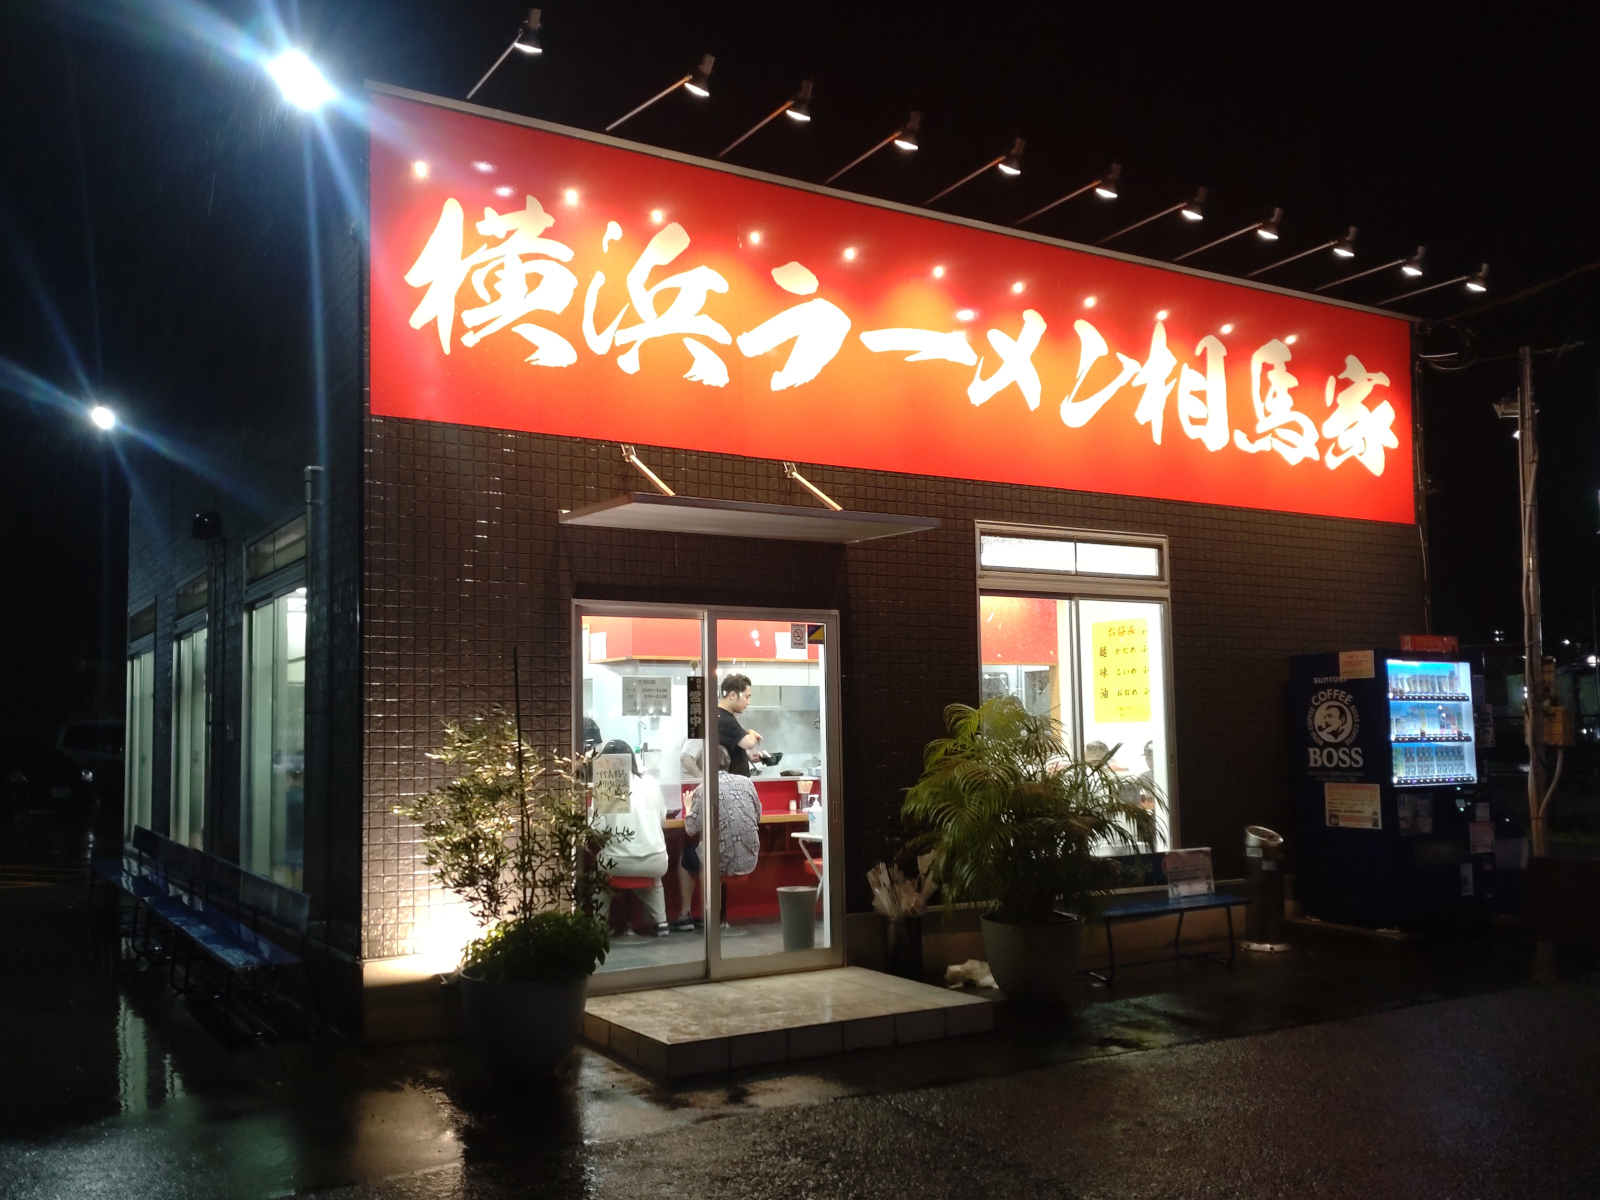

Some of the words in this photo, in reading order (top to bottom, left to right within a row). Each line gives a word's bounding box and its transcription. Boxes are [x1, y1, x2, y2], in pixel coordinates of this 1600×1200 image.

[404, 195, 1400, 478] 横浜ラーメン相馬家
[1311, 688, 1354, 706] COFFEE
[1308, 747, 1364, 768] BOSS
